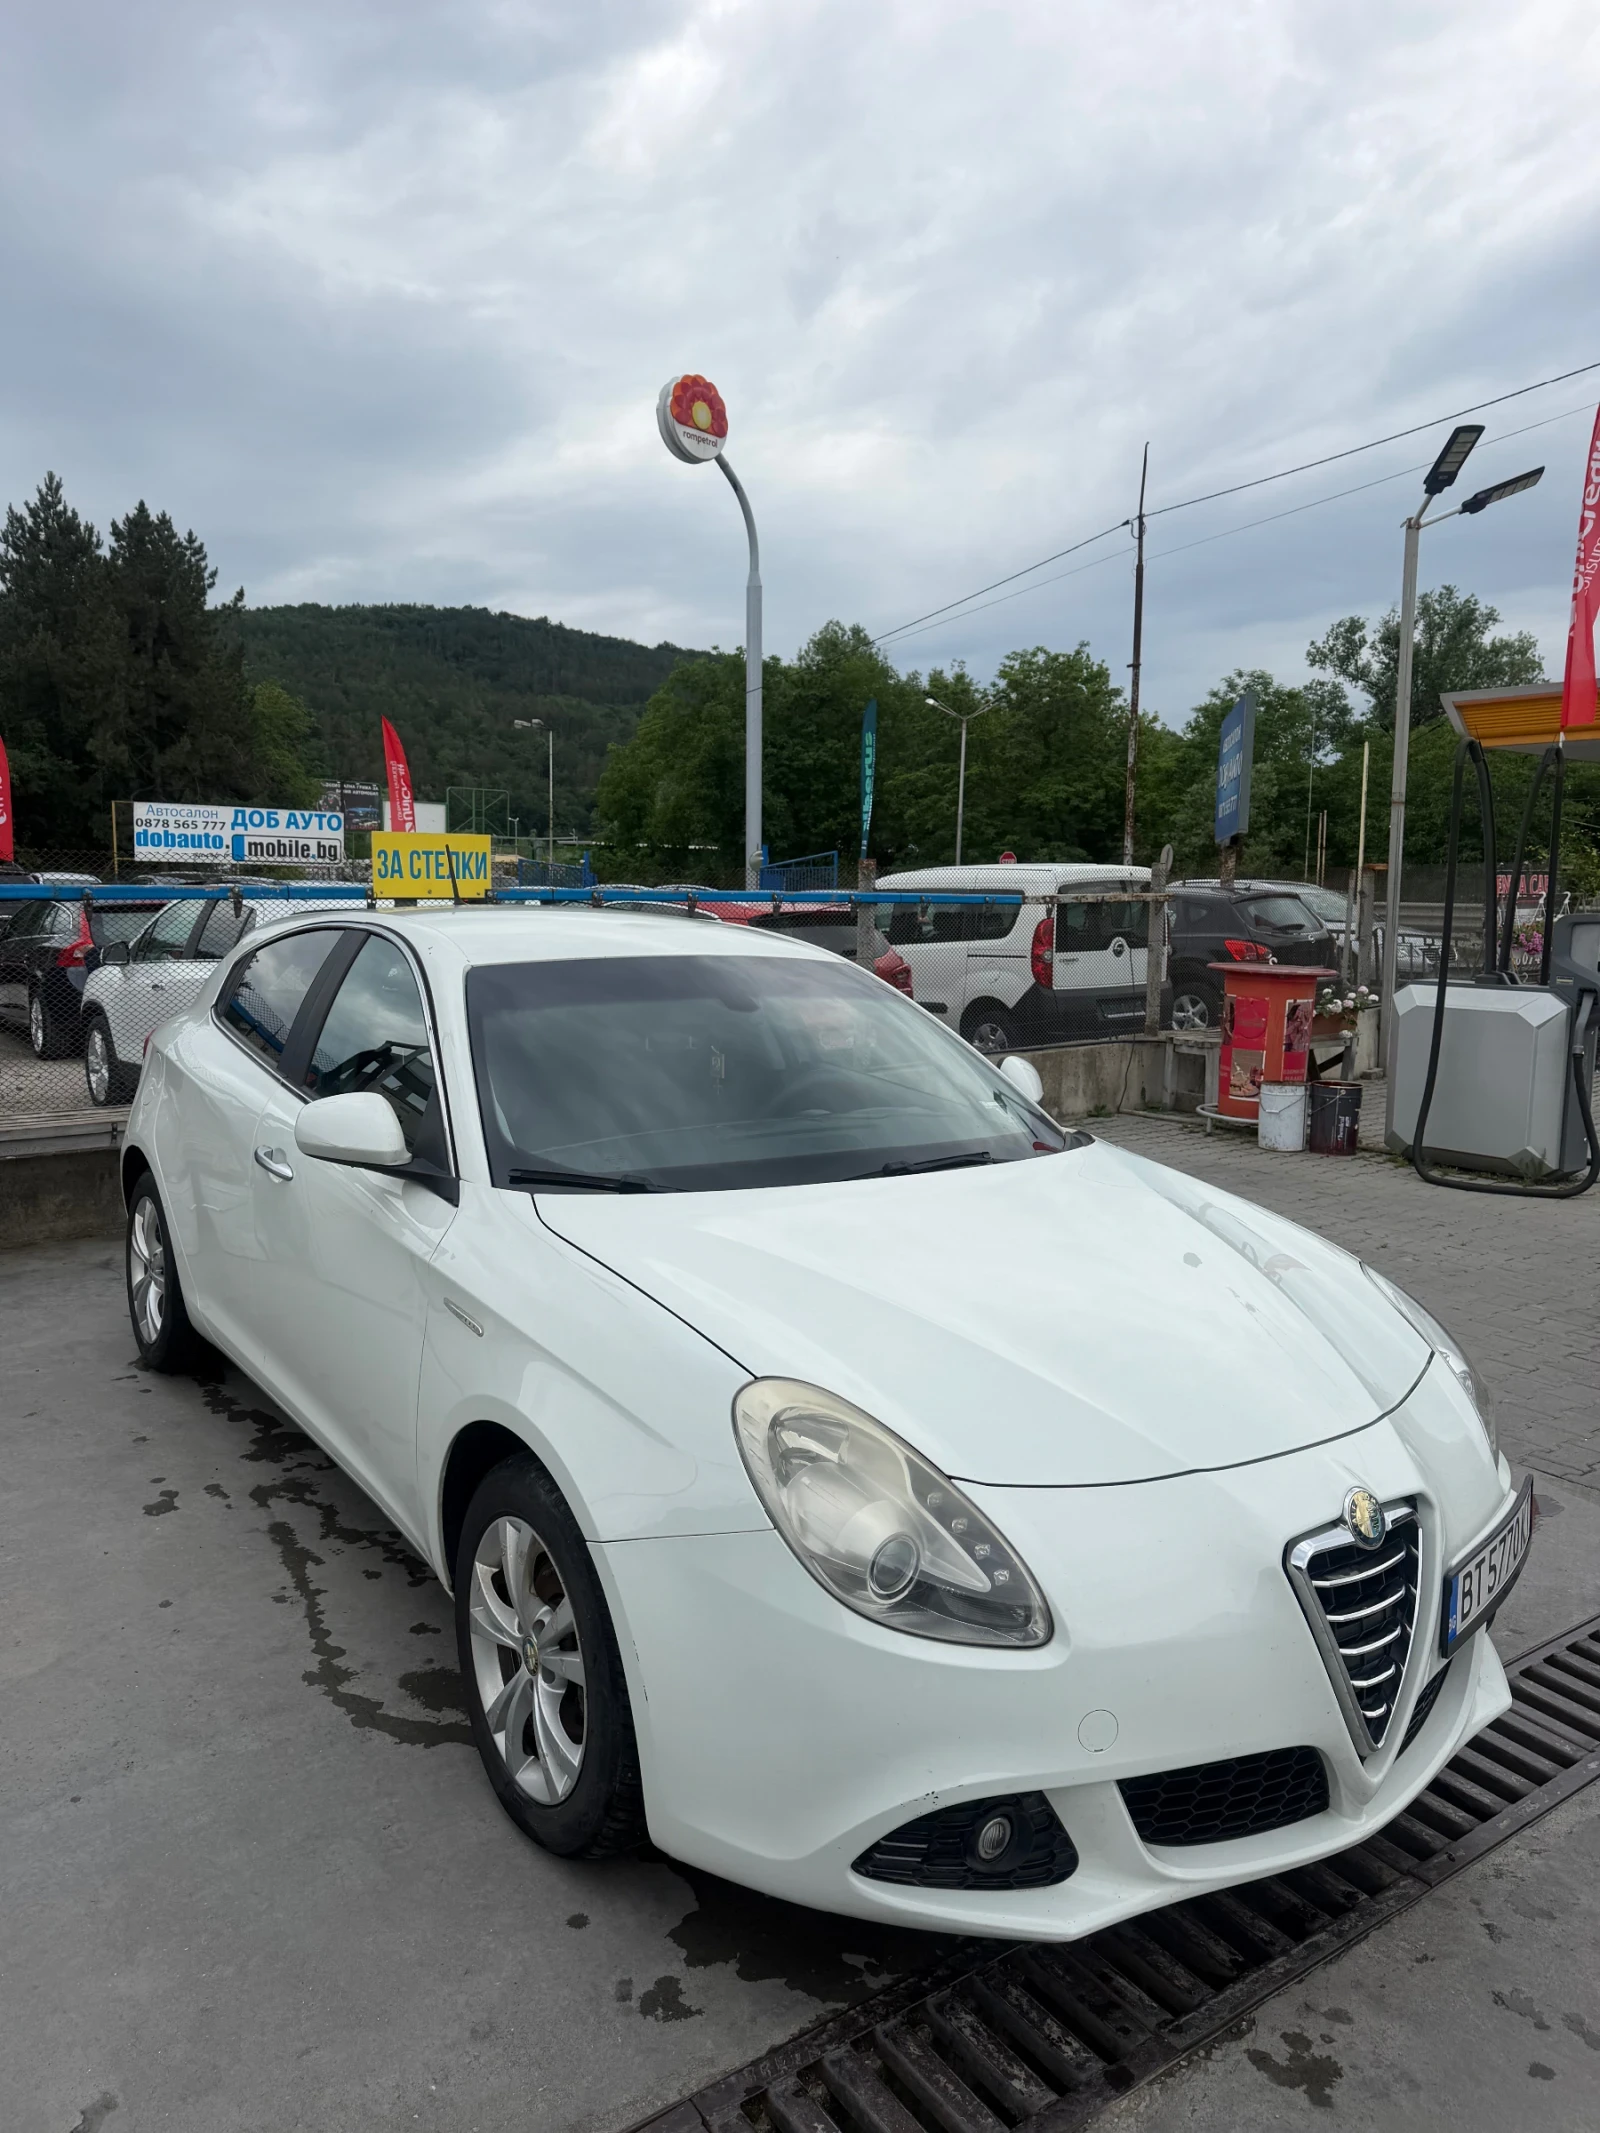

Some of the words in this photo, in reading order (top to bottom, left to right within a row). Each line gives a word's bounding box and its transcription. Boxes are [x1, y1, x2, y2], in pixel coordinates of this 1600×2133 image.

[682, 430, 718, 448] rompetrol
[146, 804, 218, 819] Автосалон
[231, 809, 280, 831] ДОБ
[285, 812, 343, 832] АУТО
[135, 818, 170, 829] 0878
[173, 819, 199, 830] 565
[202, 821, 226, 830] 777
[248, 839, 338, 861] mobile.bg
[377, 849, 404, 879] ЗА
[409, 850, 488, 880] СТЕЛКИ
